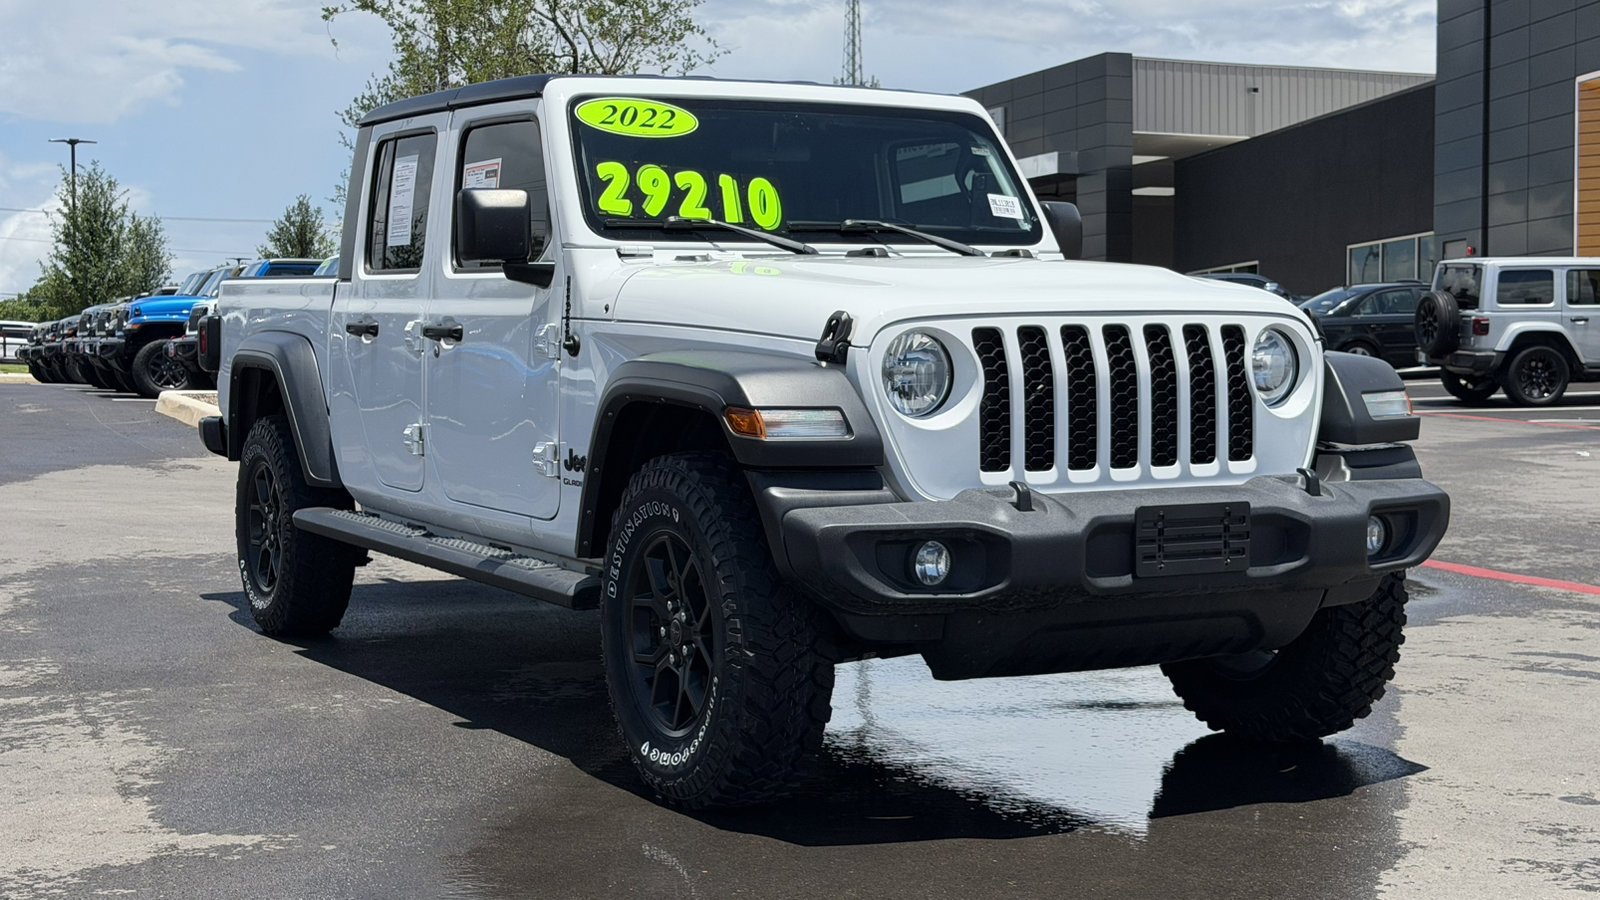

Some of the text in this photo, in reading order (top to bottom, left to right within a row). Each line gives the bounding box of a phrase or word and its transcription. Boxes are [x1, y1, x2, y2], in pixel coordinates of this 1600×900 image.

[599, 104, 676, 129] 2022
[595, 161, 782, 231] 29210
[563, 447, 587, 473] Jee
[607, 501, 671, 599] DESTINATION
